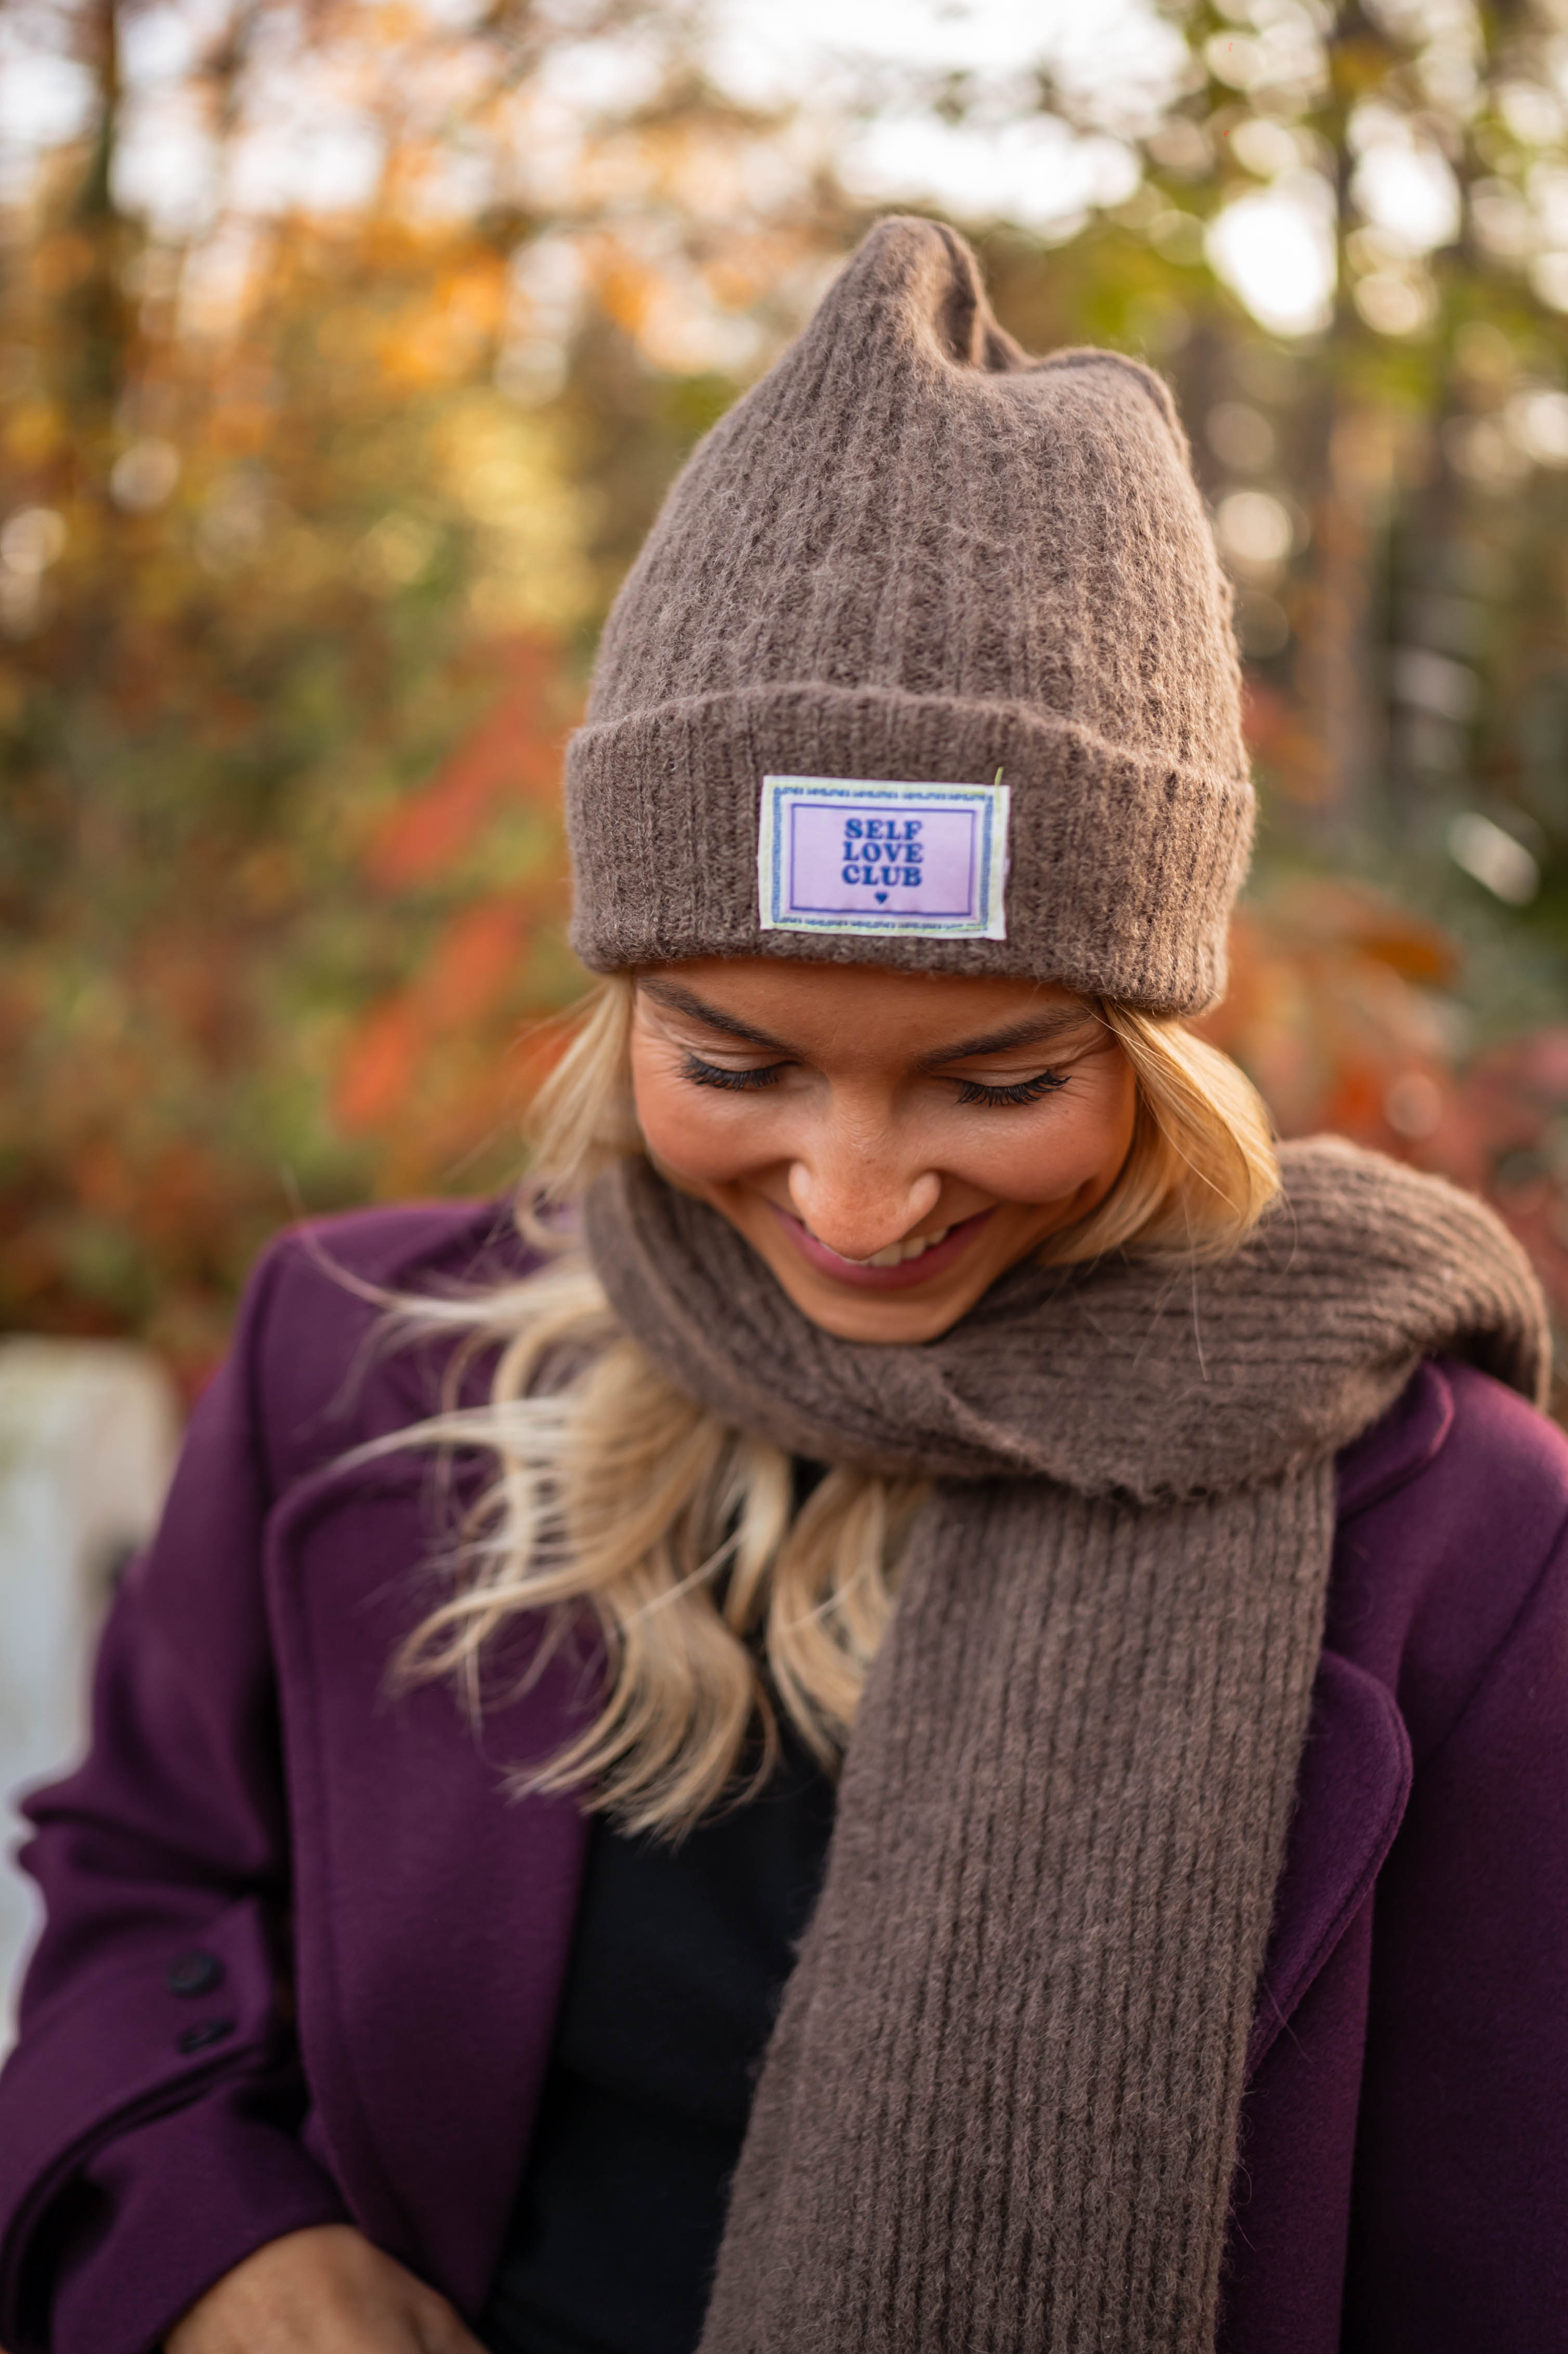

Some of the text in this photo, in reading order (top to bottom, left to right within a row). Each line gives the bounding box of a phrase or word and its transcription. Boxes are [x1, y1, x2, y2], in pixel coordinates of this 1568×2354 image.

[844, 818, 922, 841] SELF
[843, 841, 923, 864] LOVE
[841, 864, 923, 887] CLUB
